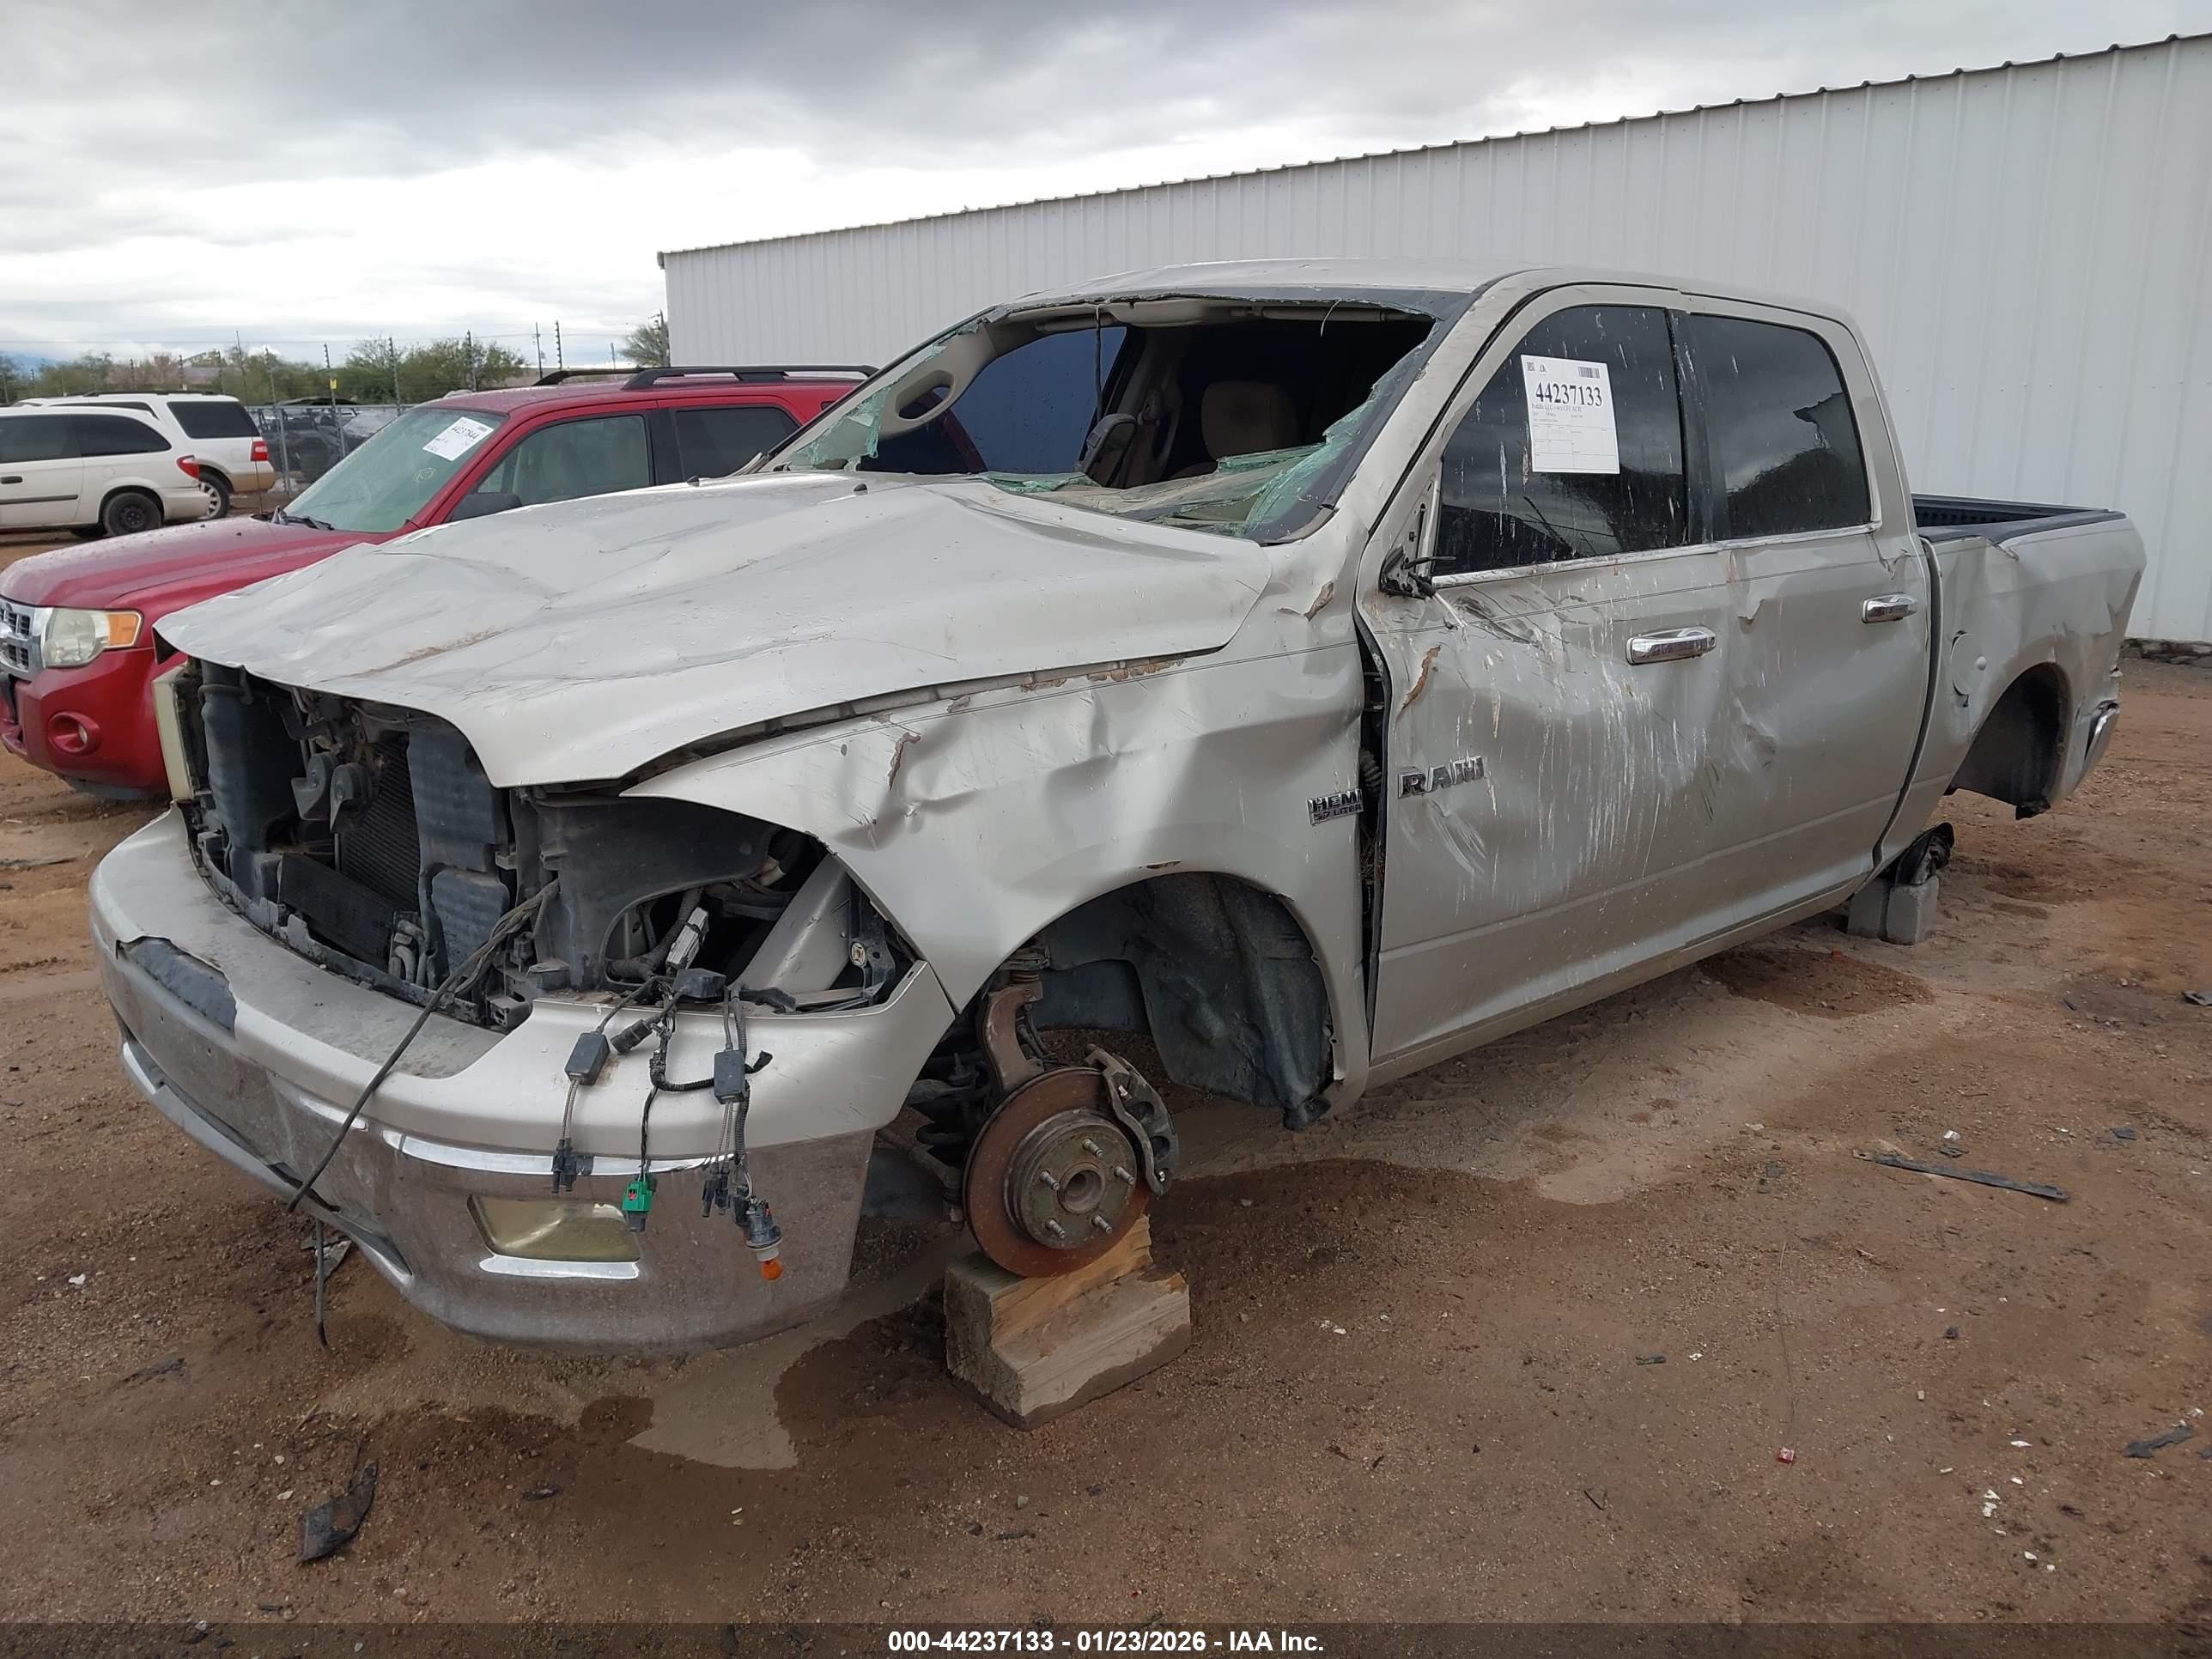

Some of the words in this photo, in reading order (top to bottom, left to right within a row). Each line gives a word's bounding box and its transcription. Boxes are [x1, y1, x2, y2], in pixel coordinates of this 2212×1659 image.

[1535, 382, 1602, 406] 44237133
[1398, 756, 1484, 799] RAM
[1308, 789, 1362, 811] HEMI
[1333, 803, 1362, 817] LITER
